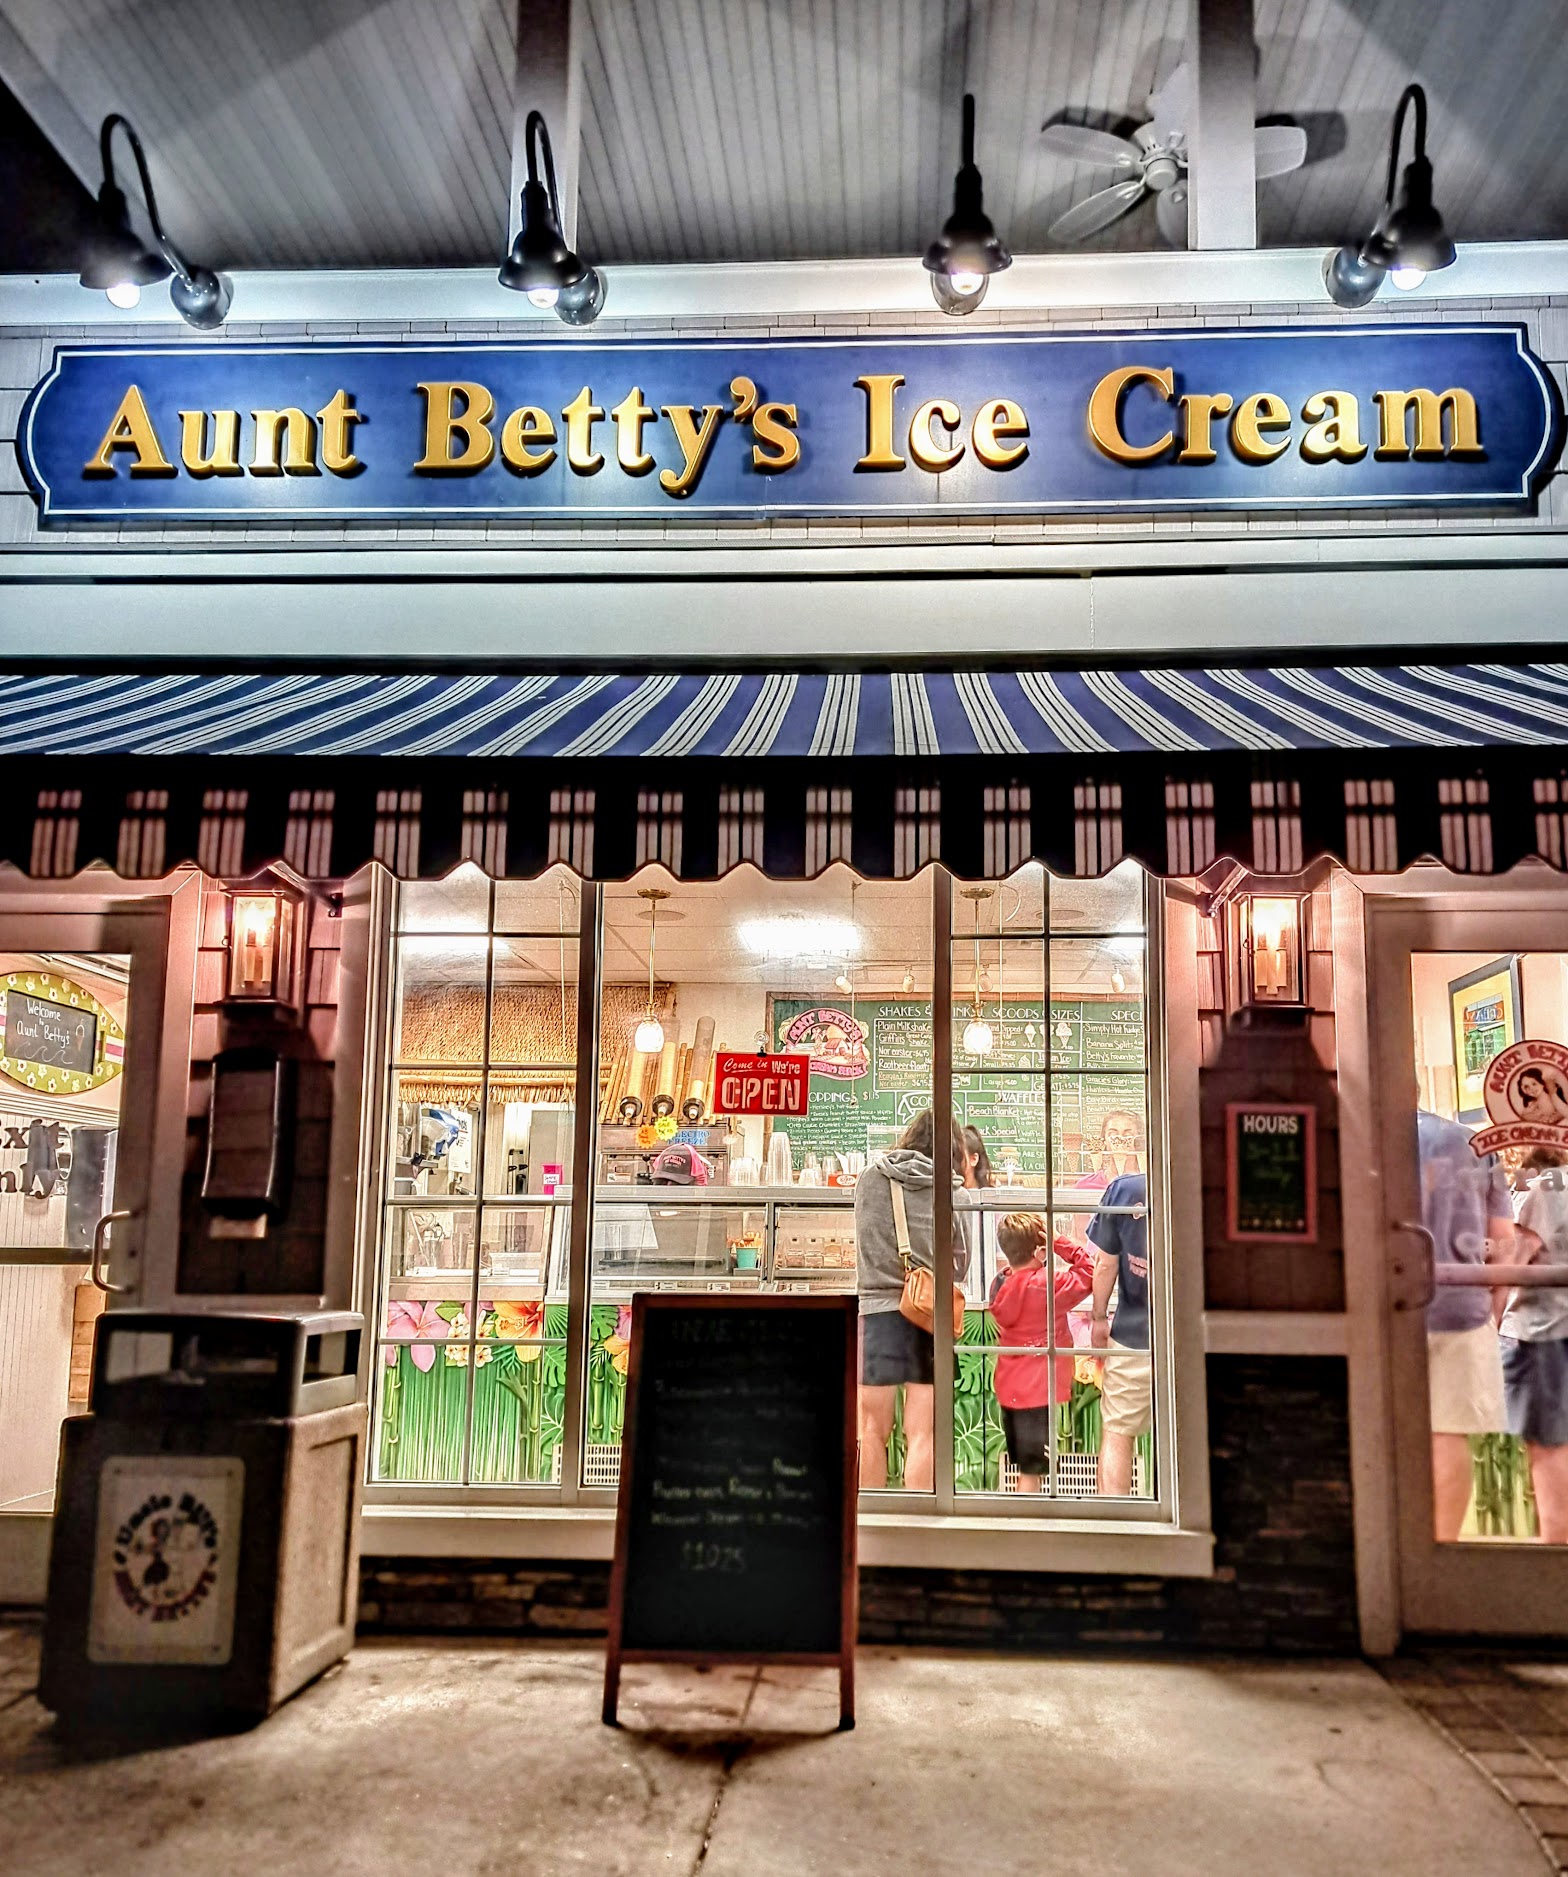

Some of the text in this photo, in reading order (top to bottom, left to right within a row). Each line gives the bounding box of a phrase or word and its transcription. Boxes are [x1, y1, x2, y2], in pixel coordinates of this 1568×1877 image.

[83, 365, 1485, 494] Aunt Betty's Ice Cream
[26, 997, 61, 1022] Welcome
[878, 1006, 921, 1017] SHAKES
[991, 1008, 1039, 1019] SCOOPS
[1050, 1010, 1080, 1021] SIZES
[1111, 1010, 1143, 1021] SPECI
[878, 1020, 896, 1031] Plain
[1084, 1023, 1110, 1037] Simply
[1110, 1024, 1122, 1034] Hot
[44, 1024, 70, 1049] Betty's
[1086, 1037, 1114, 1048] Banana
[1086, 1050, 1110, 1062] Betty's
[723, 1058, 801, 1075] Come in We're
[1085, 1074, 1111, 1084] Gracie's
[721, 1076, 800, 1111] OPEN
[808, 1091, 858, 1104] OPPINGS
[1001, 1093, 1046, 1104] WAFFLES
[910, 1095, 934, 1107] CON
[968, 1105, 992, 1116] Beach
[1243, 1114, 1299, 1134] HOURS
[0, 1118, 64, 1149] xit
[675, 1130, 710, 1138] LECTRO
[0, 1162, 60, 1200] nly
